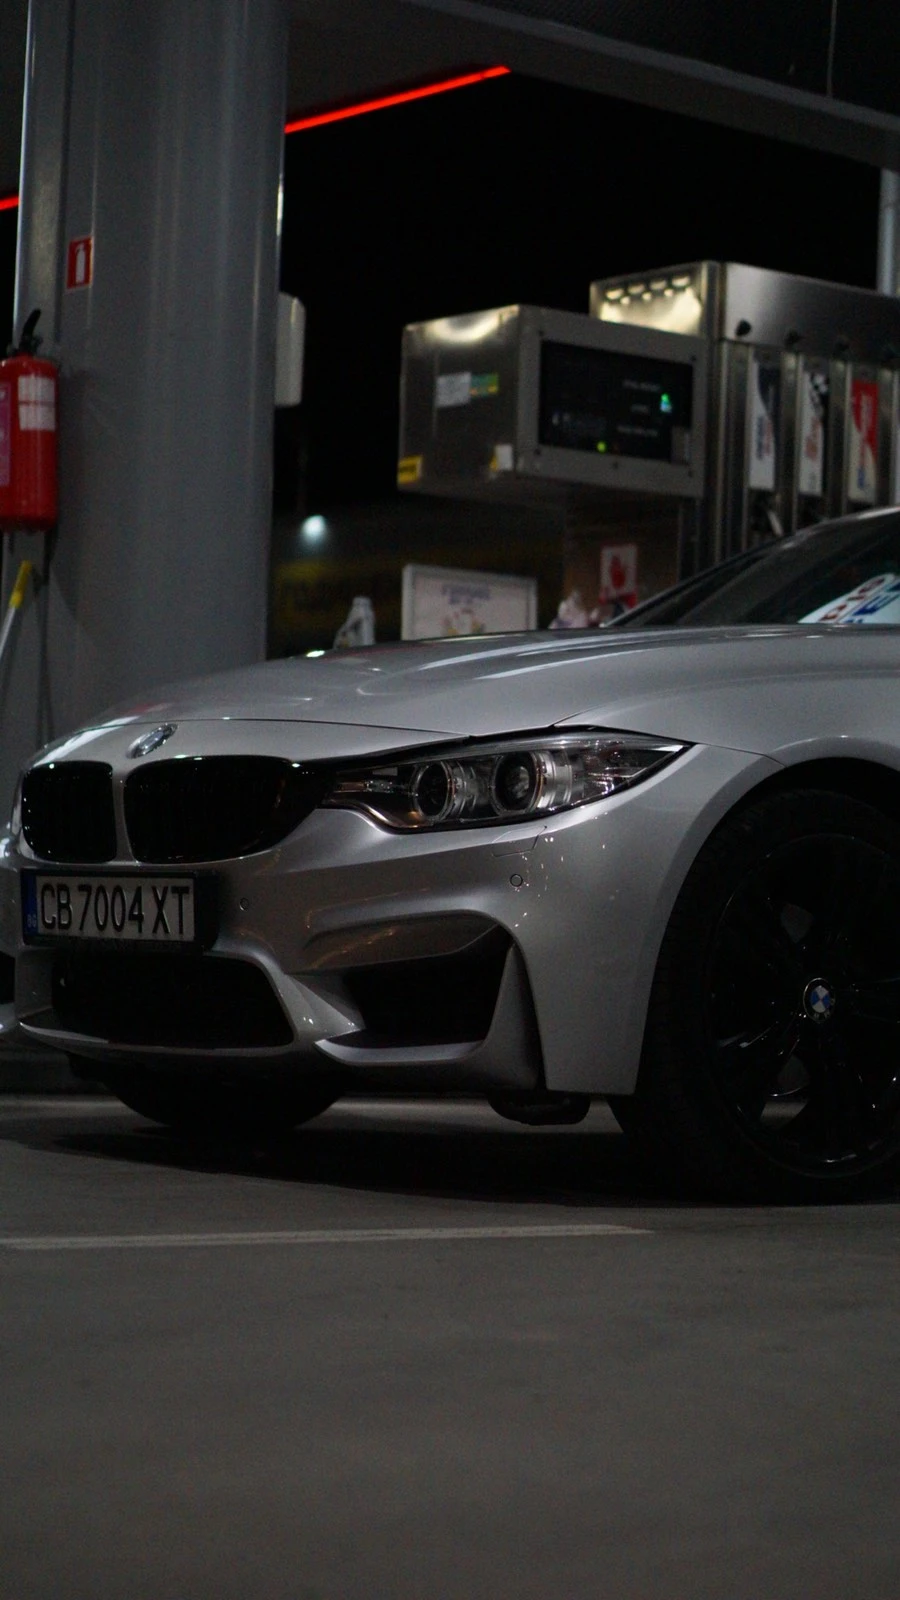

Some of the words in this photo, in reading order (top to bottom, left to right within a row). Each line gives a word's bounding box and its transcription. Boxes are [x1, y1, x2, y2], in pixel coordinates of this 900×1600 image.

[41, 884, 72, 930] CB
[78, 884, 144, 933] 7004
[152, 886, 190, 934] XT
